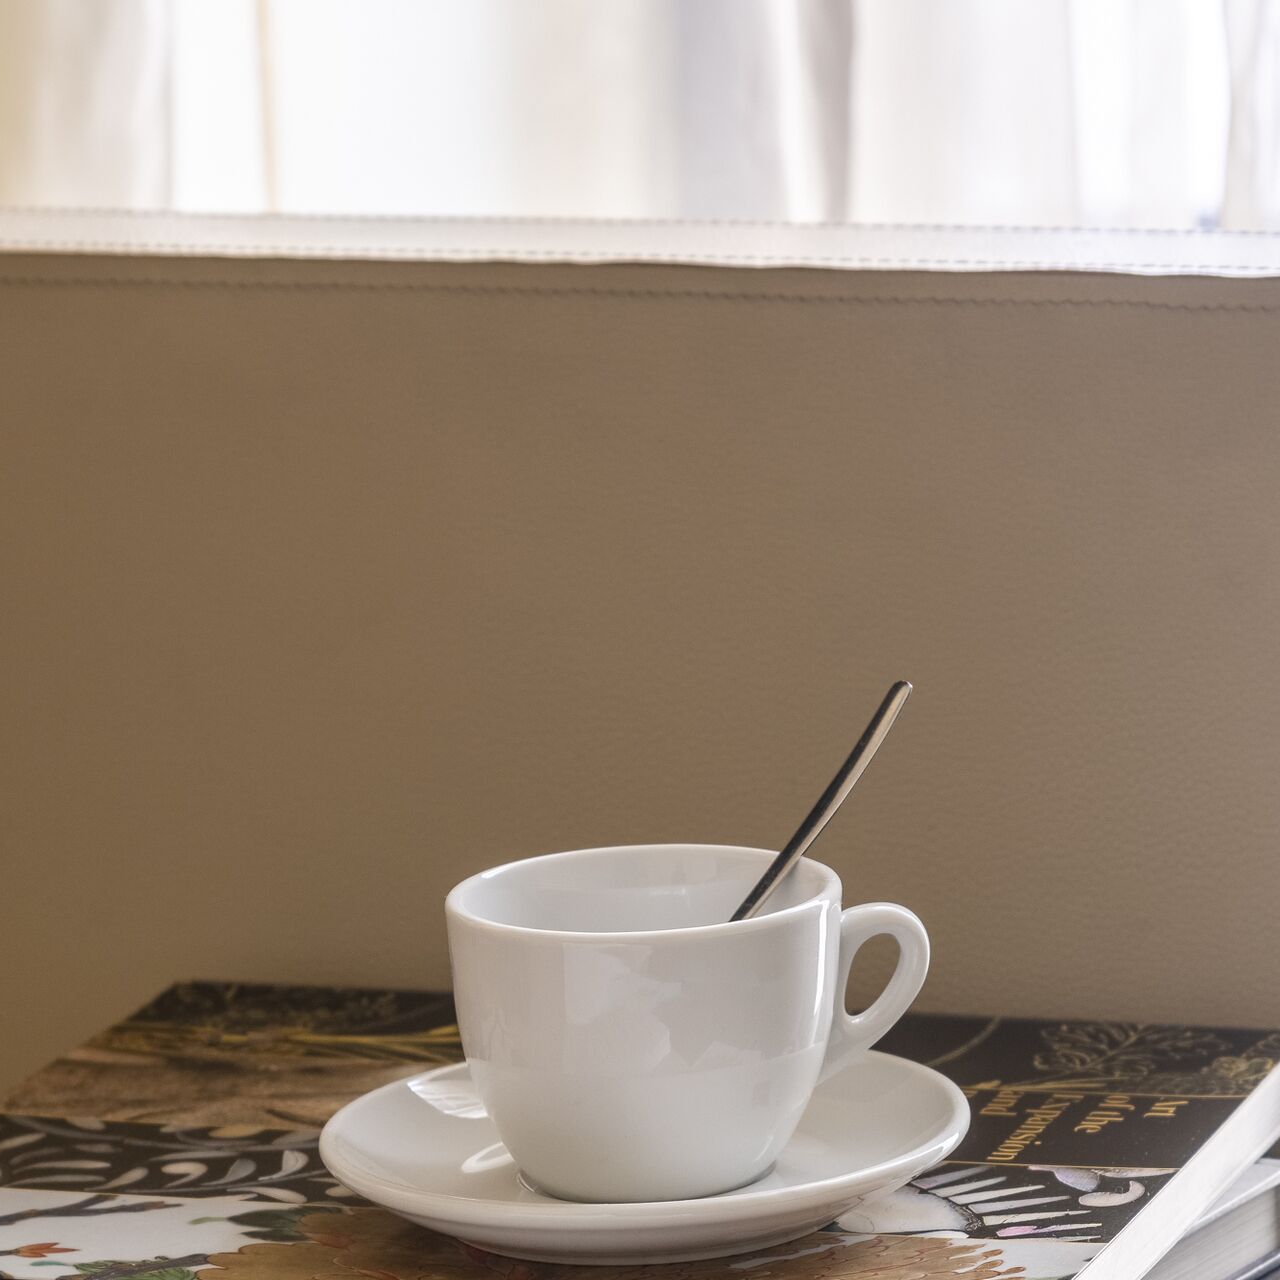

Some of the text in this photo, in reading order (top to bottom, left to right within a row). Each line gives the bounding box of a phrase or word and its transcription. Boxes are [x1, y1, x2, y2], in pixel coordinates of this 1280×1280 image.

[979, 1090, 1024, 1117] and
[1074, 1095, 1135, 1133] of the
[1144, 1097, 1189, 1118] Art
[986, 1093, 1085, 1161] Expansion
